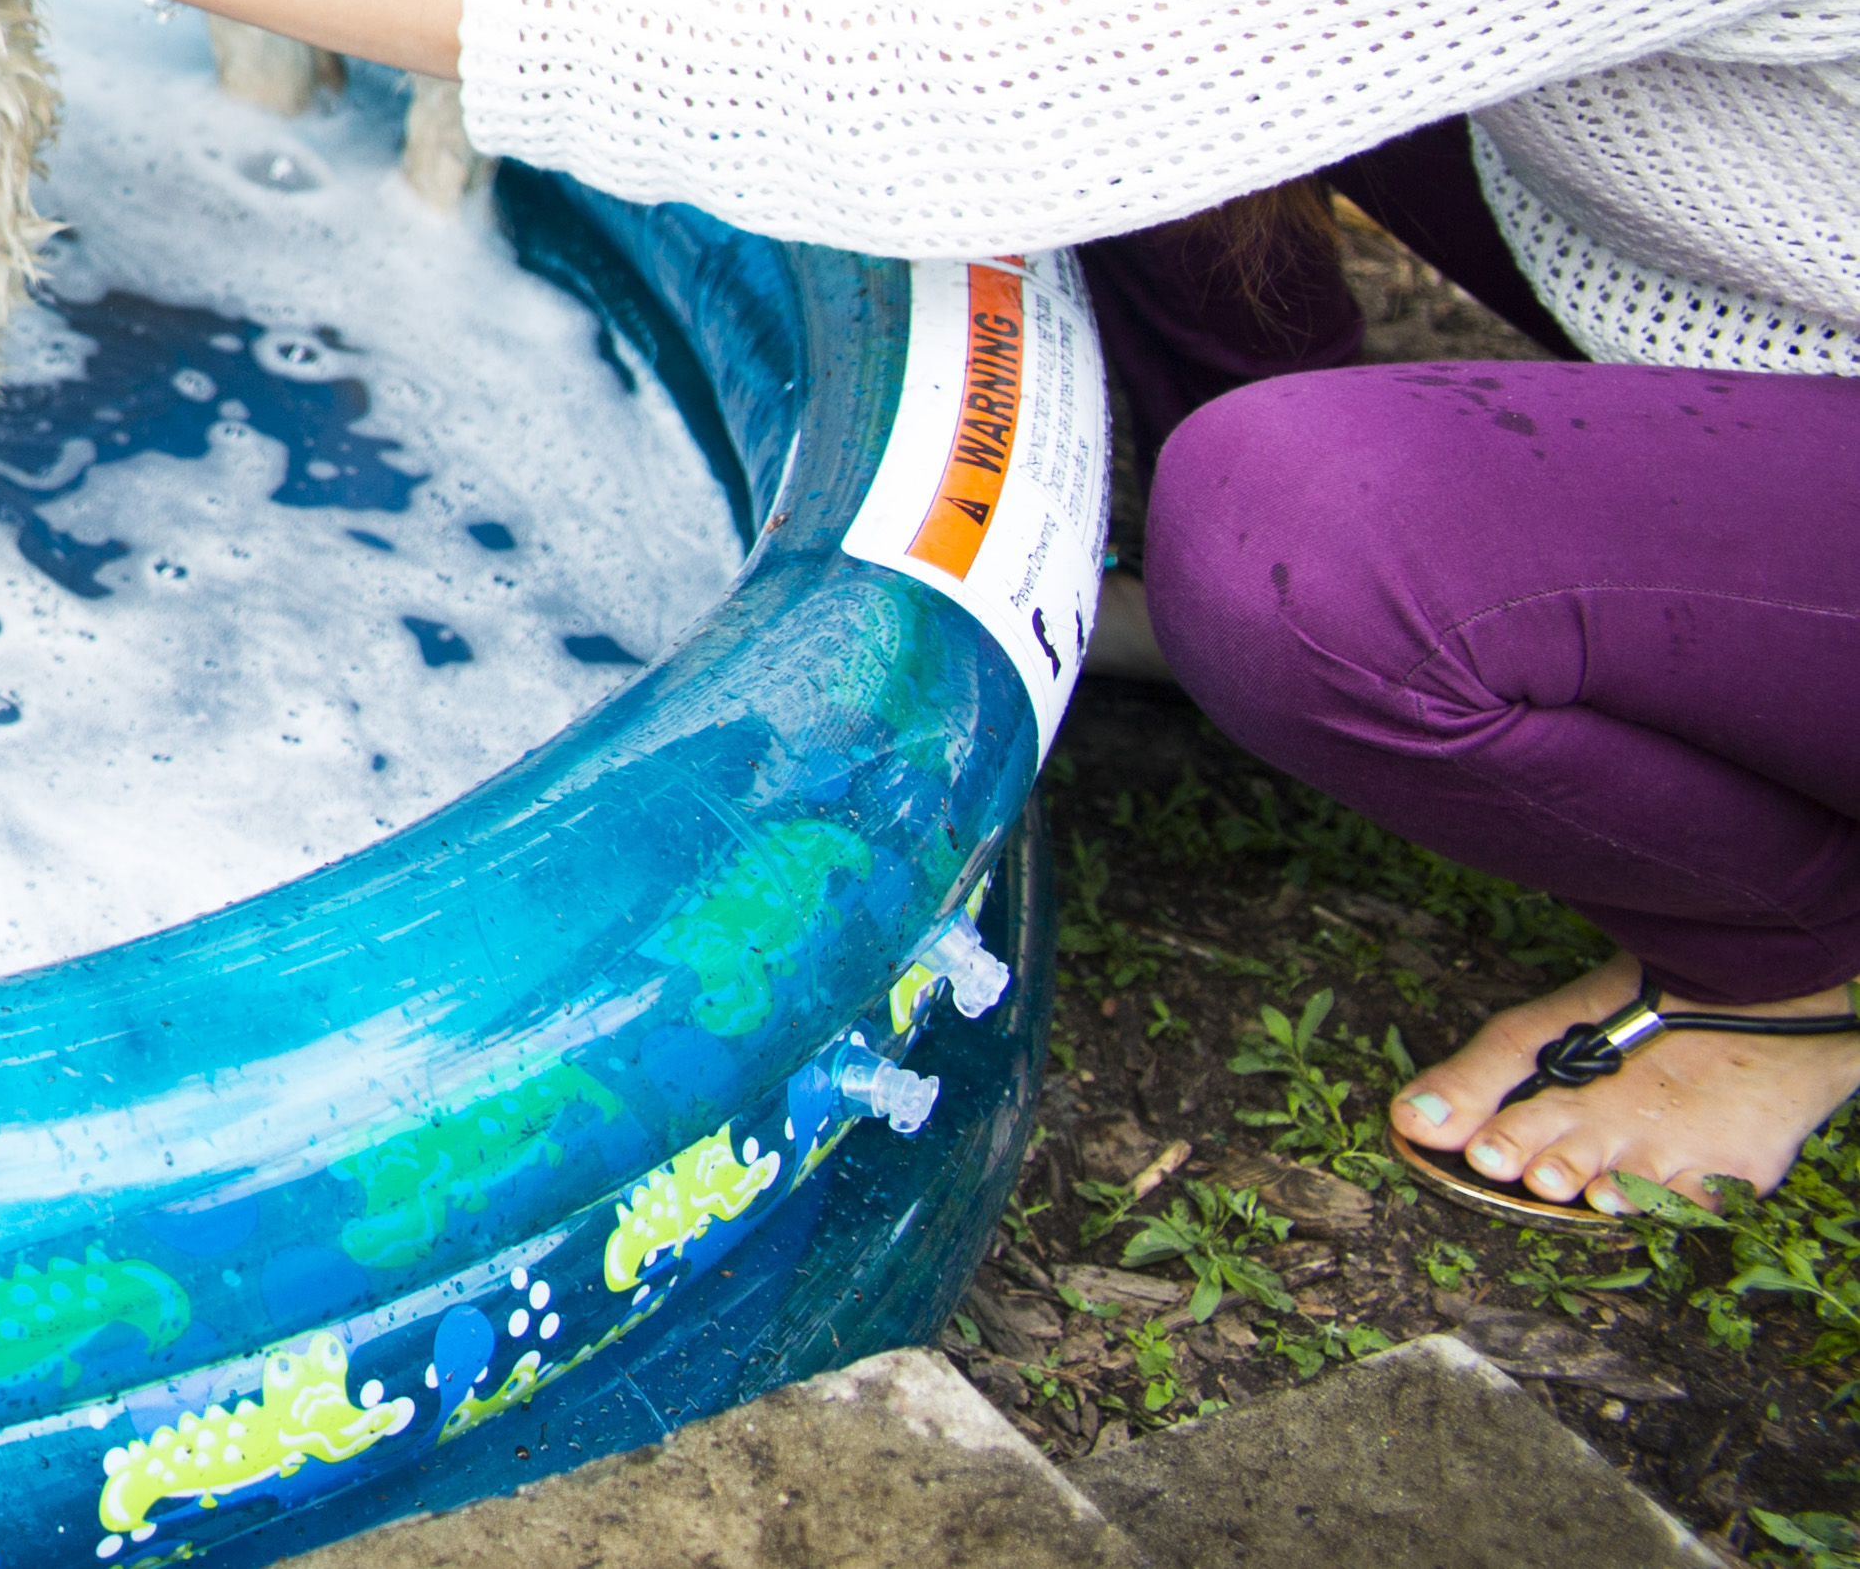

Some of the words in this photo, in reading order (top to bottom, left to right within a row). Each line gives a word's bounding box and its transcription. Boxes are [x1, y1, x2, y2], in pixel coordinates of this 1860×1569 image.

[954, 312, 1019, 474] WARNING
[1010, 564, 1039, 614] Prevent
[1028, 512, 1059, 570] Drowning
